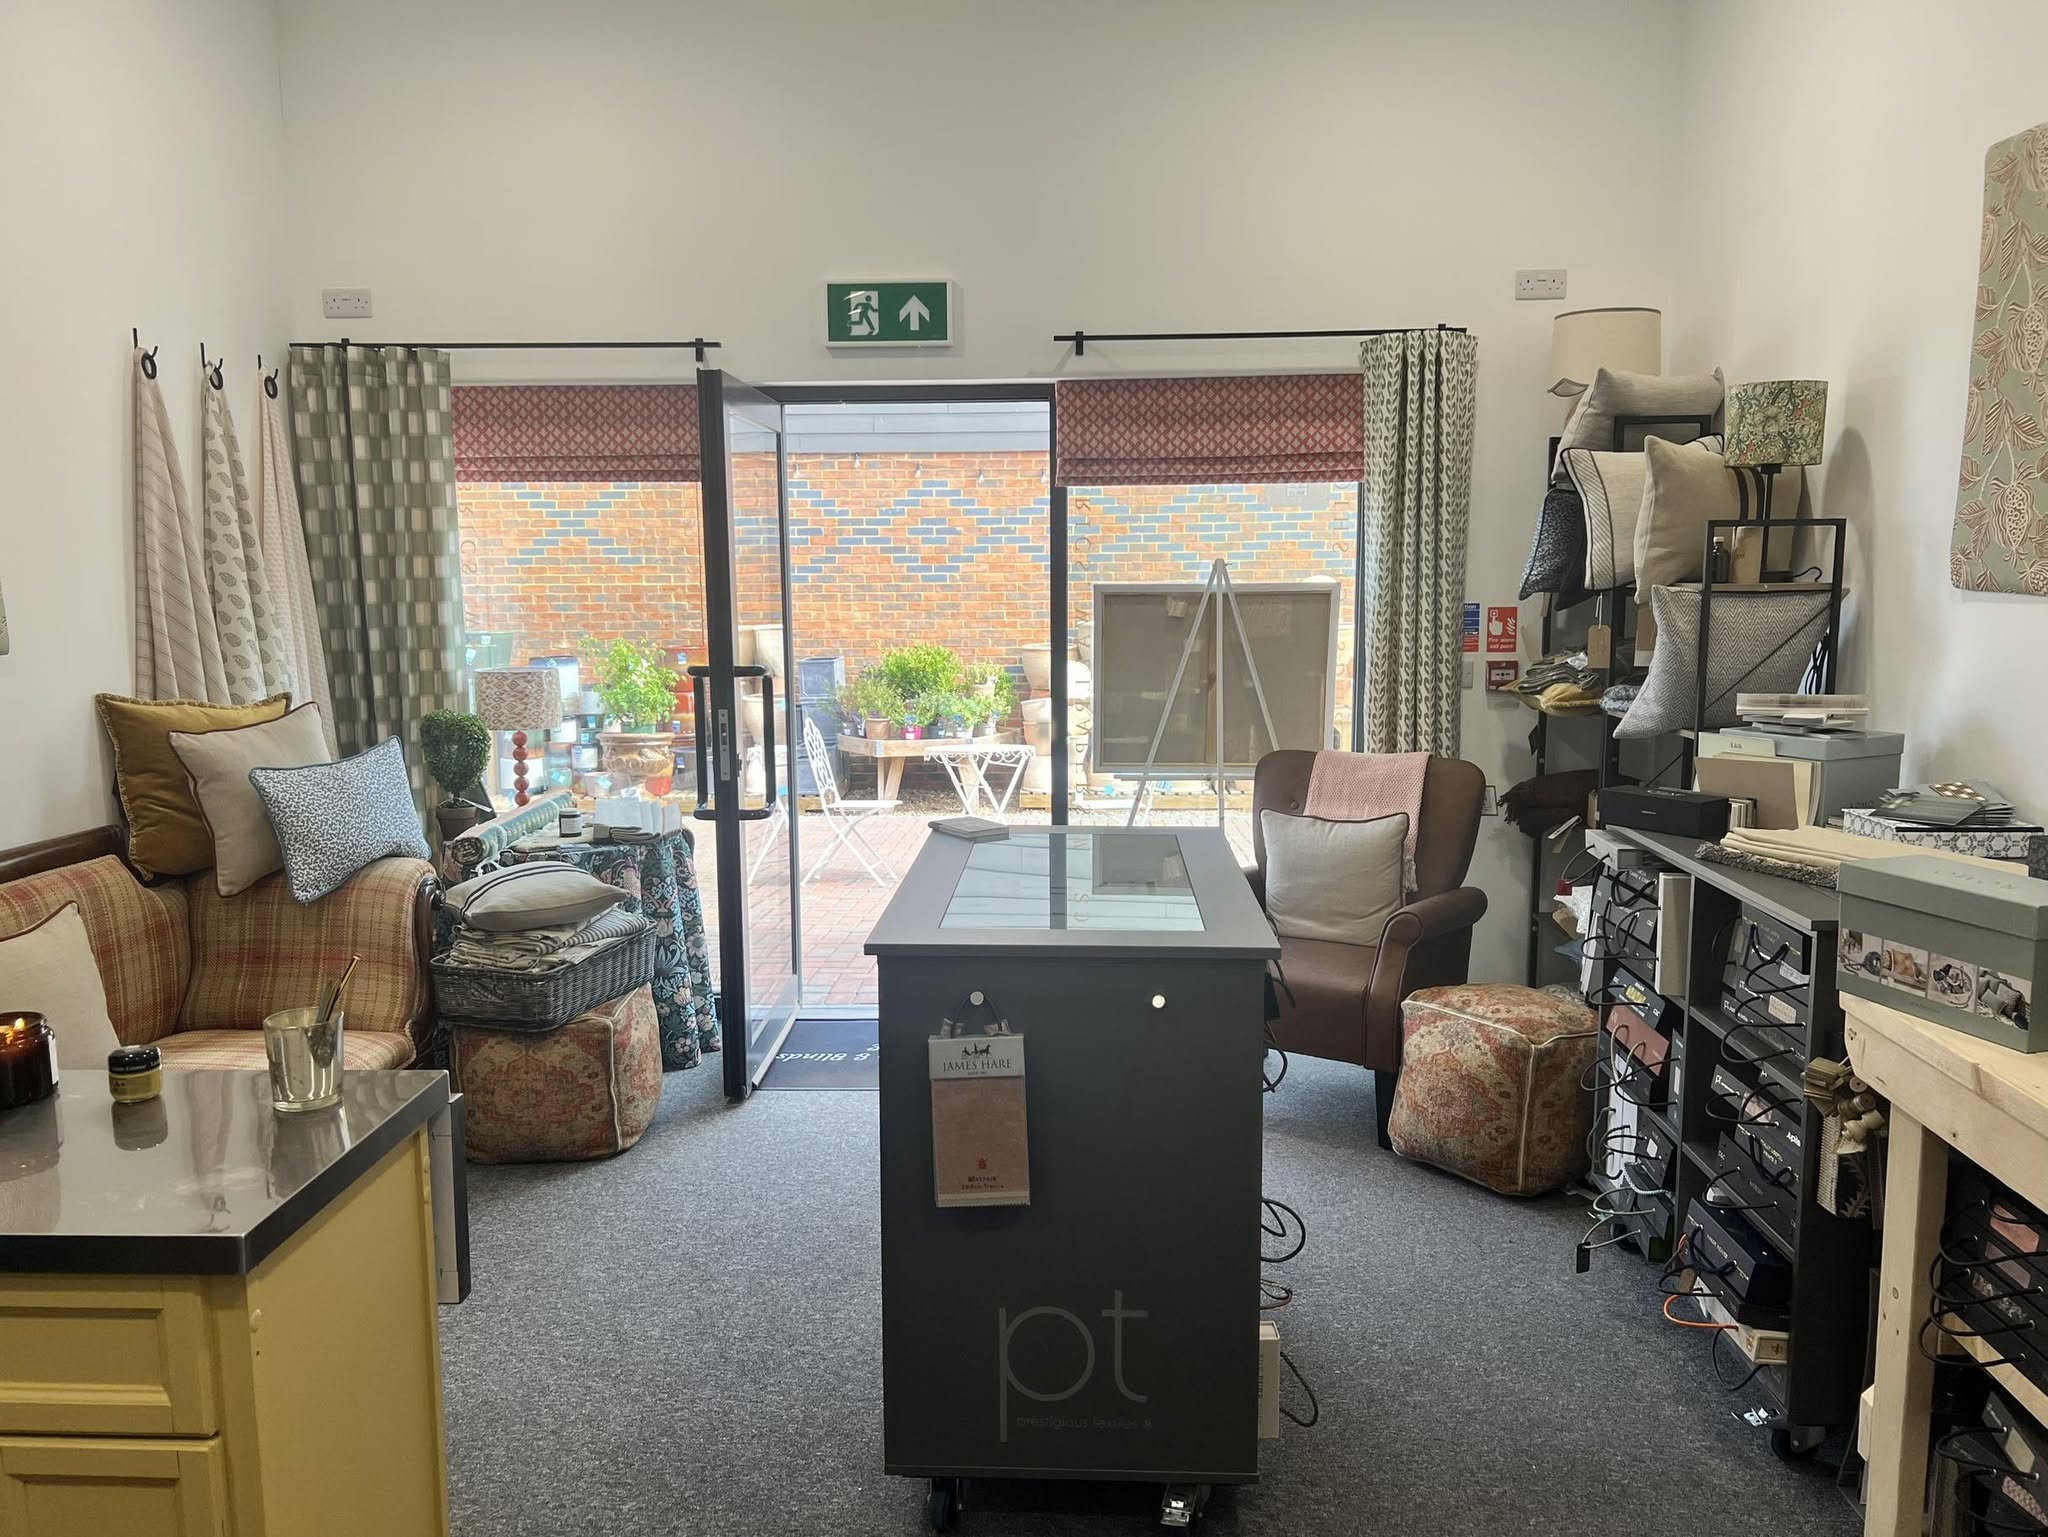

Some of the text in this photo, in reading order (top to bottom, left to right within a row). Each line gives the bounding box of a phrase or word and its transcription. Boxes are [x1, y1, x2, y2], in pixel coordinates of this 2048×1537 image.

[775, 1052, 848, 1063] Blinds
[943, 1058, 1012, 1072] JAMES HARE
[998, 1289, 1149, 1443] pt
